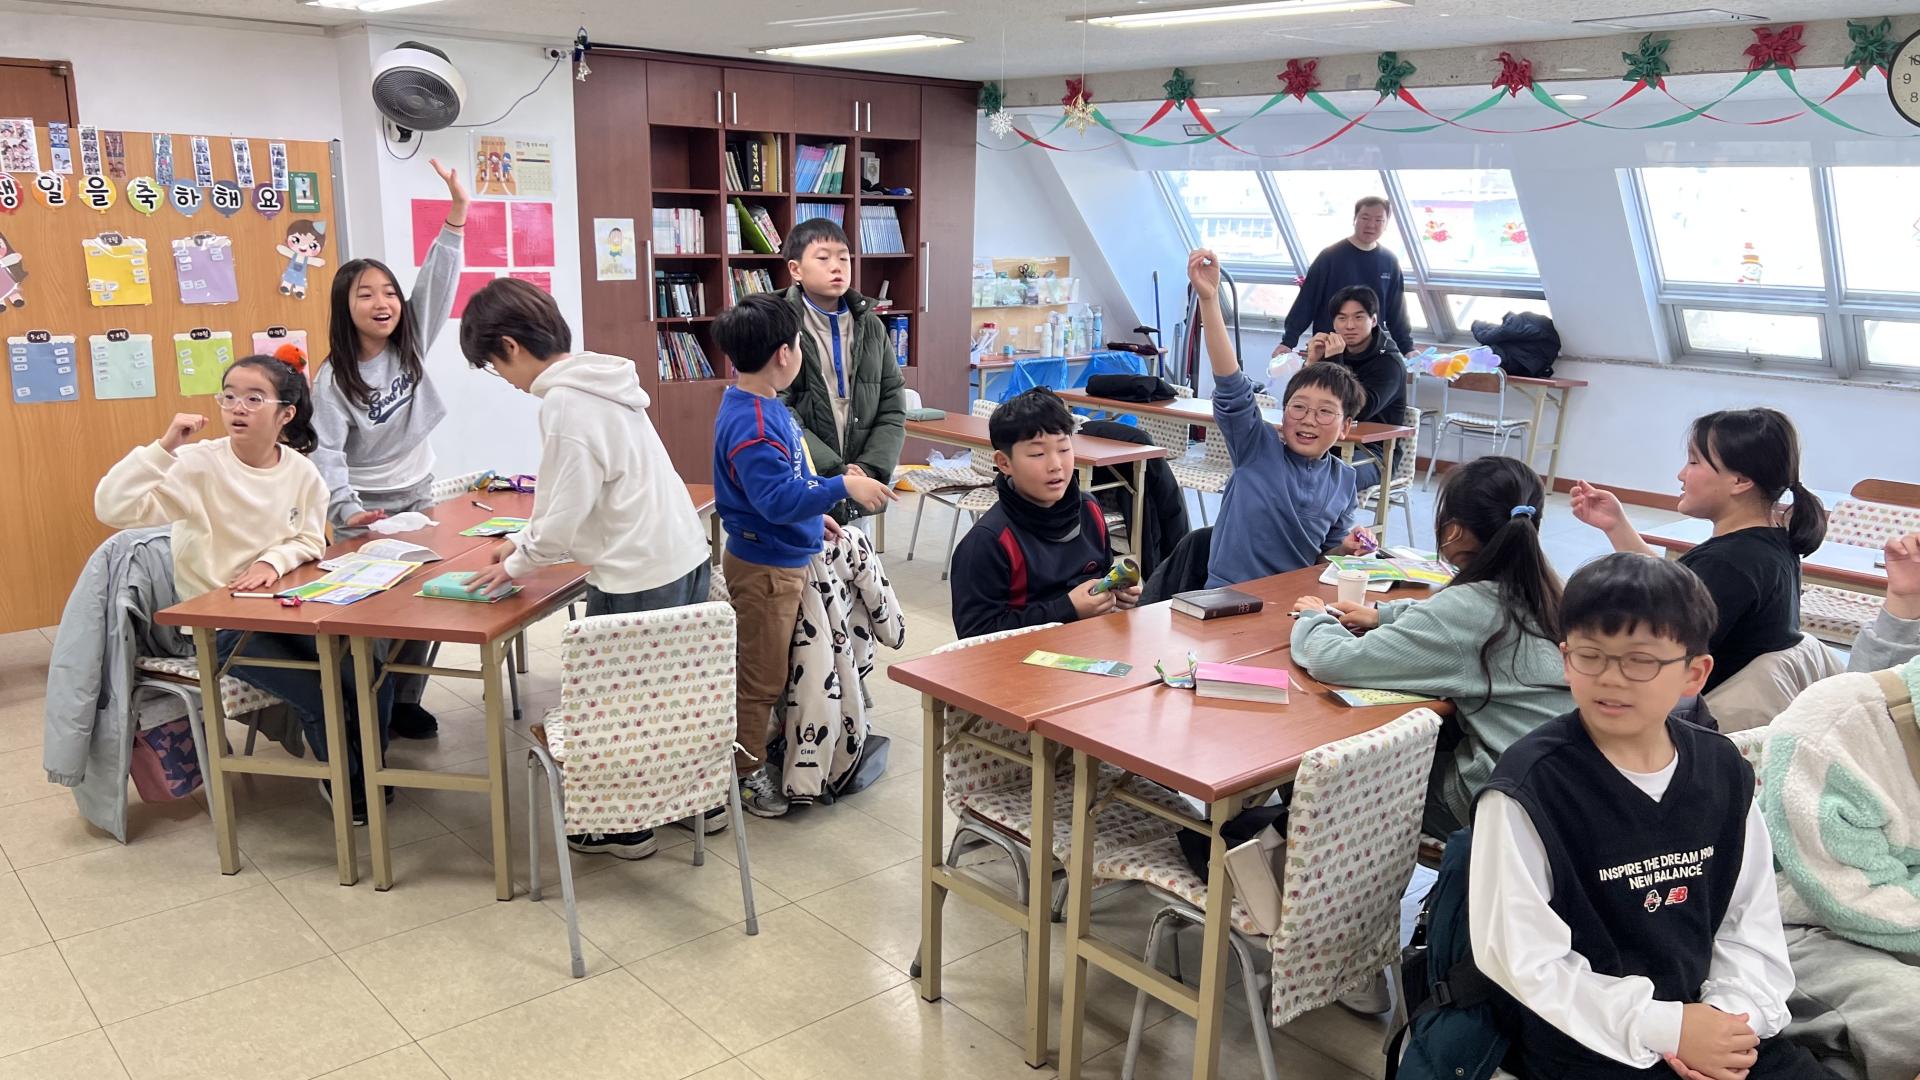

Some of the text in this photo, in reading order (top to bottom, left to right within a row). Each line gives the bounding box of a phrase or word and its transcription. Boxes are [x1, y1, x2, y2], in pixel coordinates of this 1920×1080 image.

[1903, 73, 1912, 84] 9
[1910, 91, 1919, 103] 8
[1598, 862, 1643, 882] INSPIRE
[1642, 857, 1661, 873] THE
[1660, 851, 1699, 867] DREAM
[1628, 864, 1703, 890] NEW BALANCE
